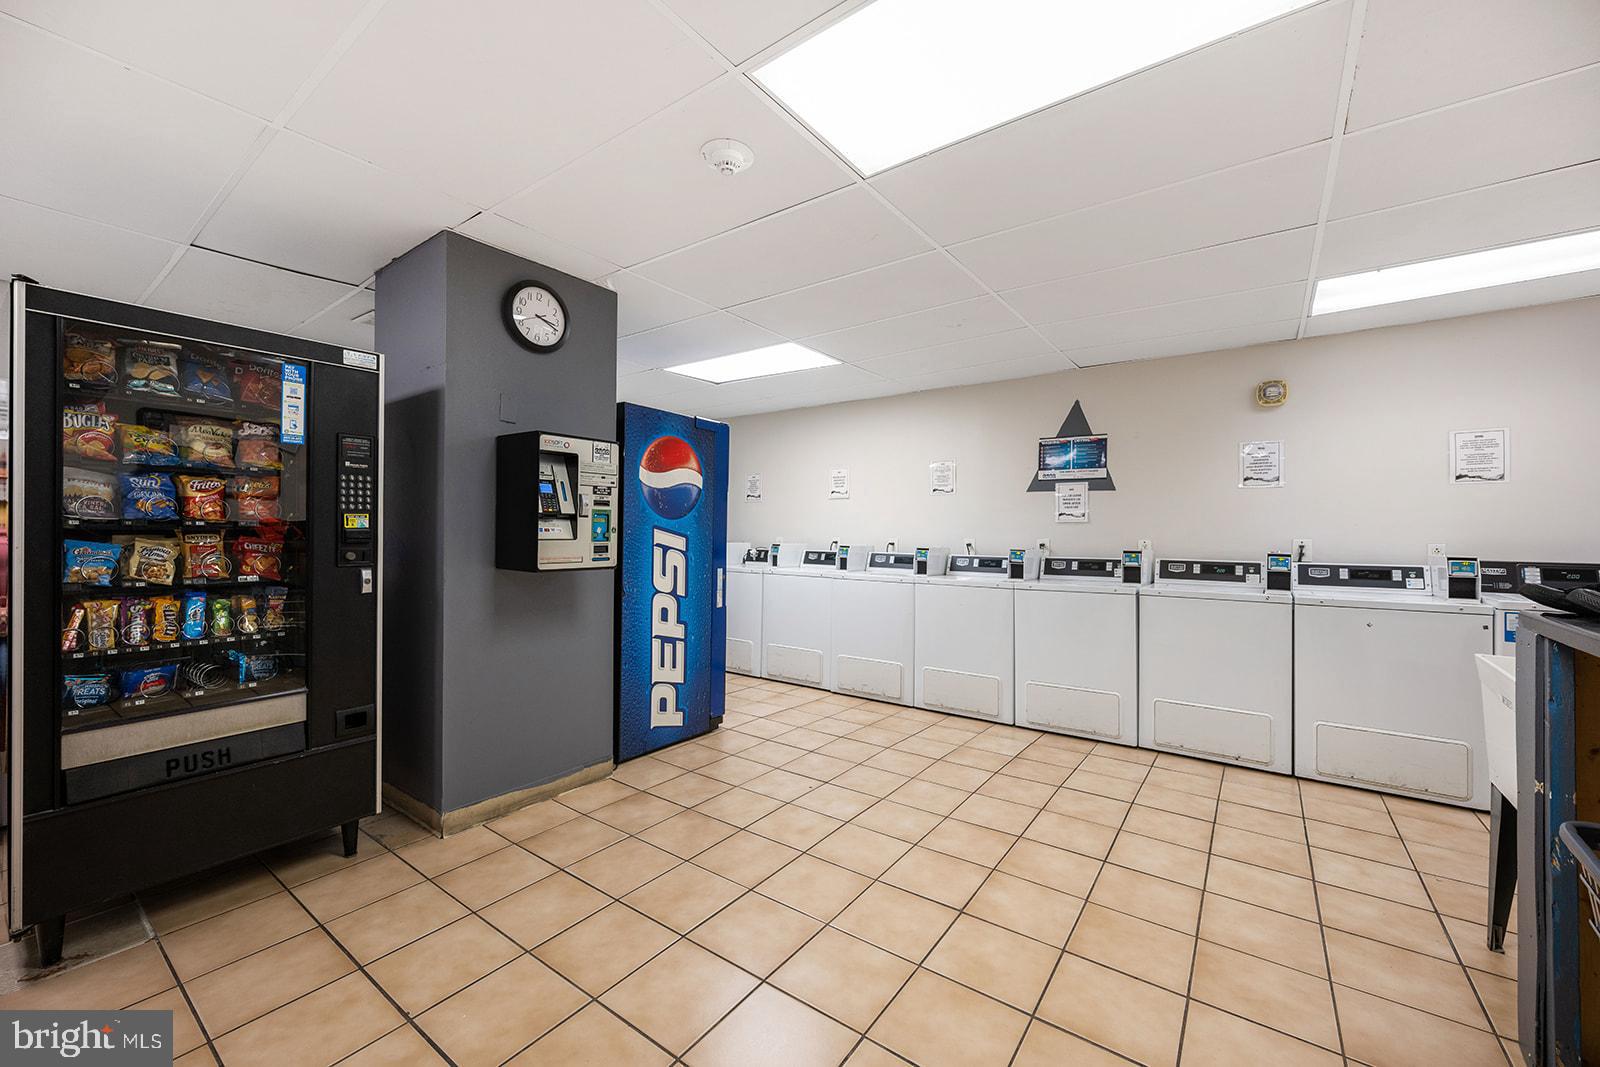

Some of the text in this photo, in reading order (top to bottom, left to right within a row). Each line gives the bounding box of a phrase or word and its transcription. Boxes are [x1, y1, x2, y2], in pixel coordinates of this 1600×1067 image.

[519, 296, 527, 306] 10
[536, 292, 543, 302] 12
[190, 480, 221, 491] Fritos
[650, 527, 687, 730] PEPSI
[166, 747, 232, 778] PUSH
